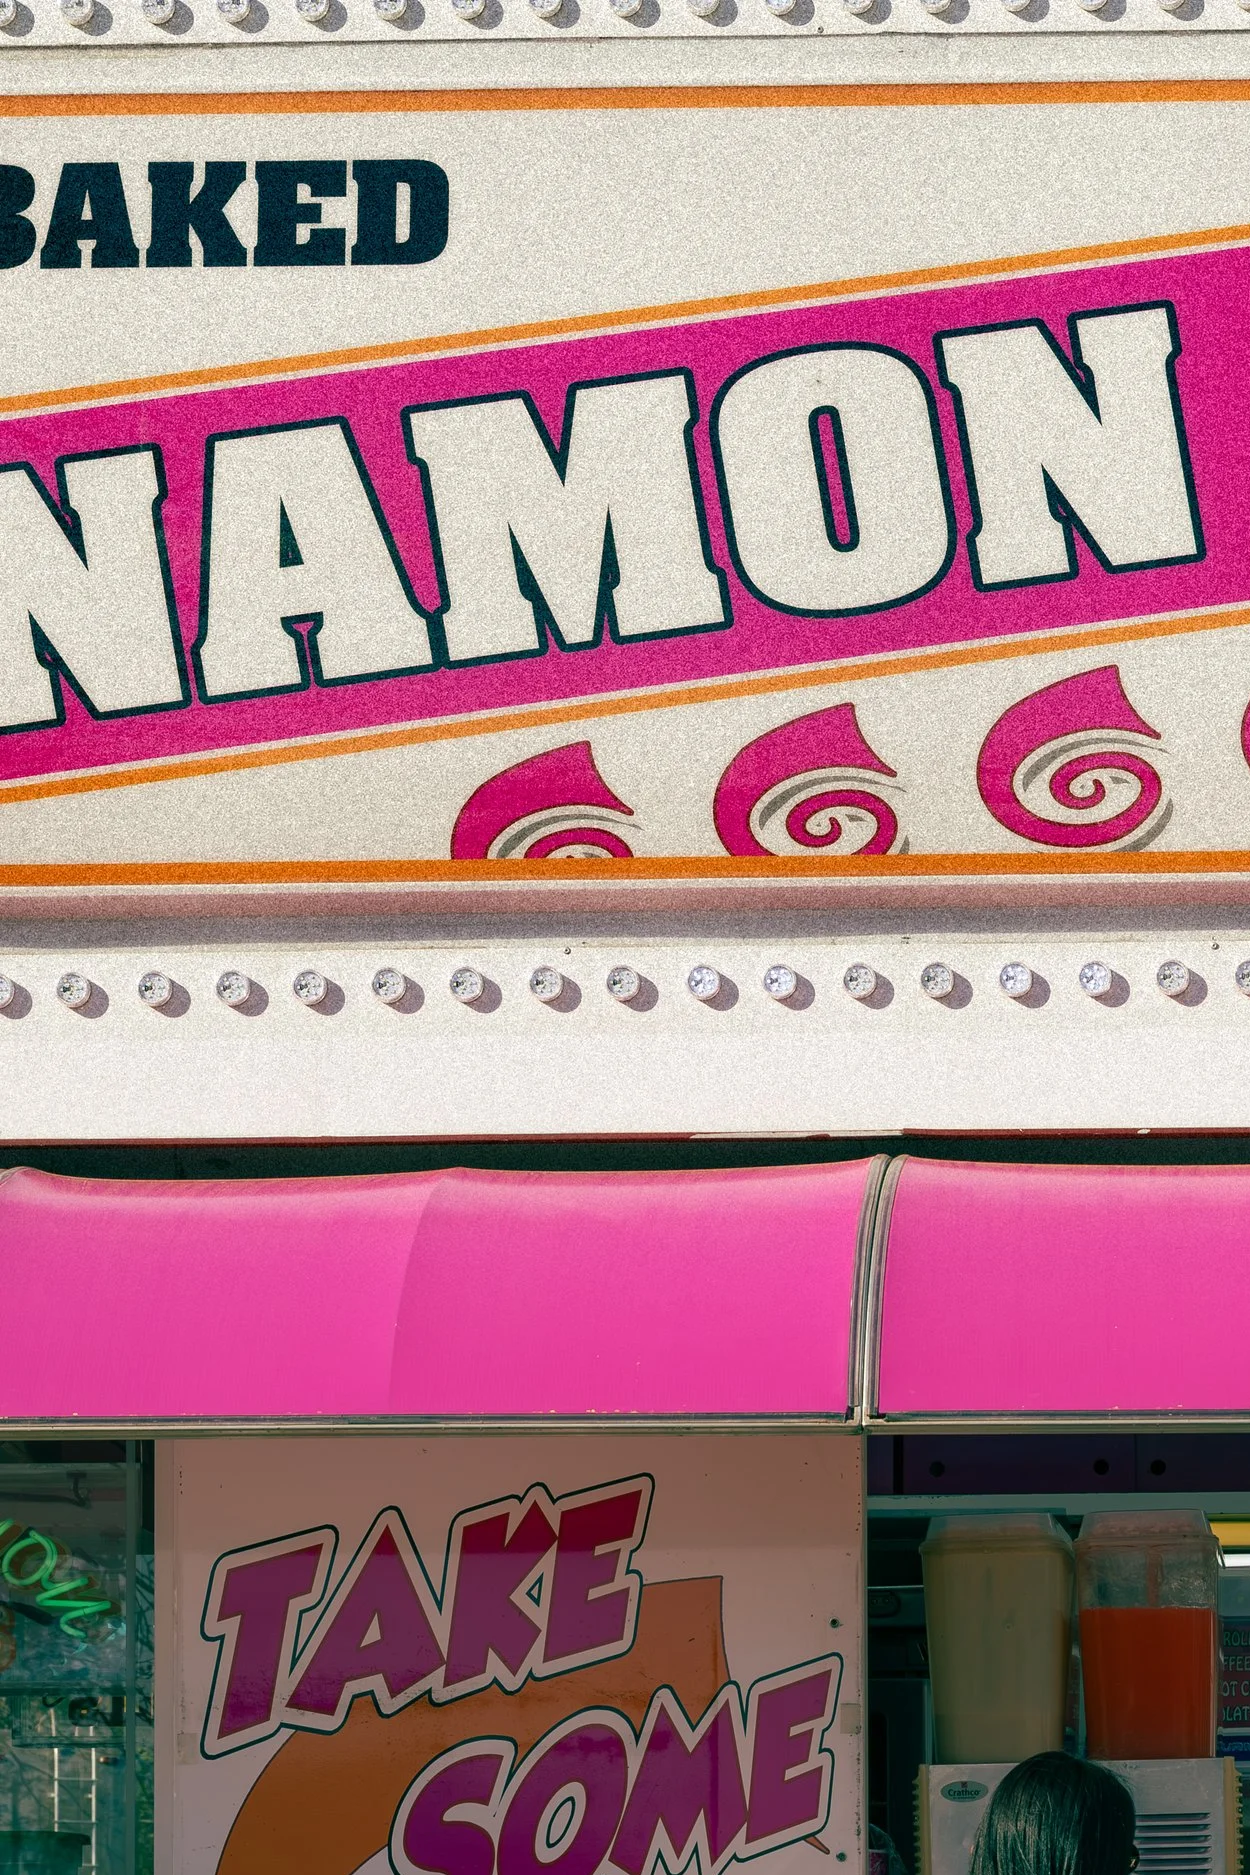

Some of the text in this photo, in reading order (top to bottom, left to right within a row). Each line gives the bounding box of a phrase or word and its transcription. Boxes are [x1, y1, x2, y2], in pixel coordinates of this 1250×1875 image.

[0, 159, 450, 269] BAKED
[0, 300, 1205, 735] NAMON
[203, 1474, 654, 1758] TAKE
[947, 1788, 979, 1797] Crathco
